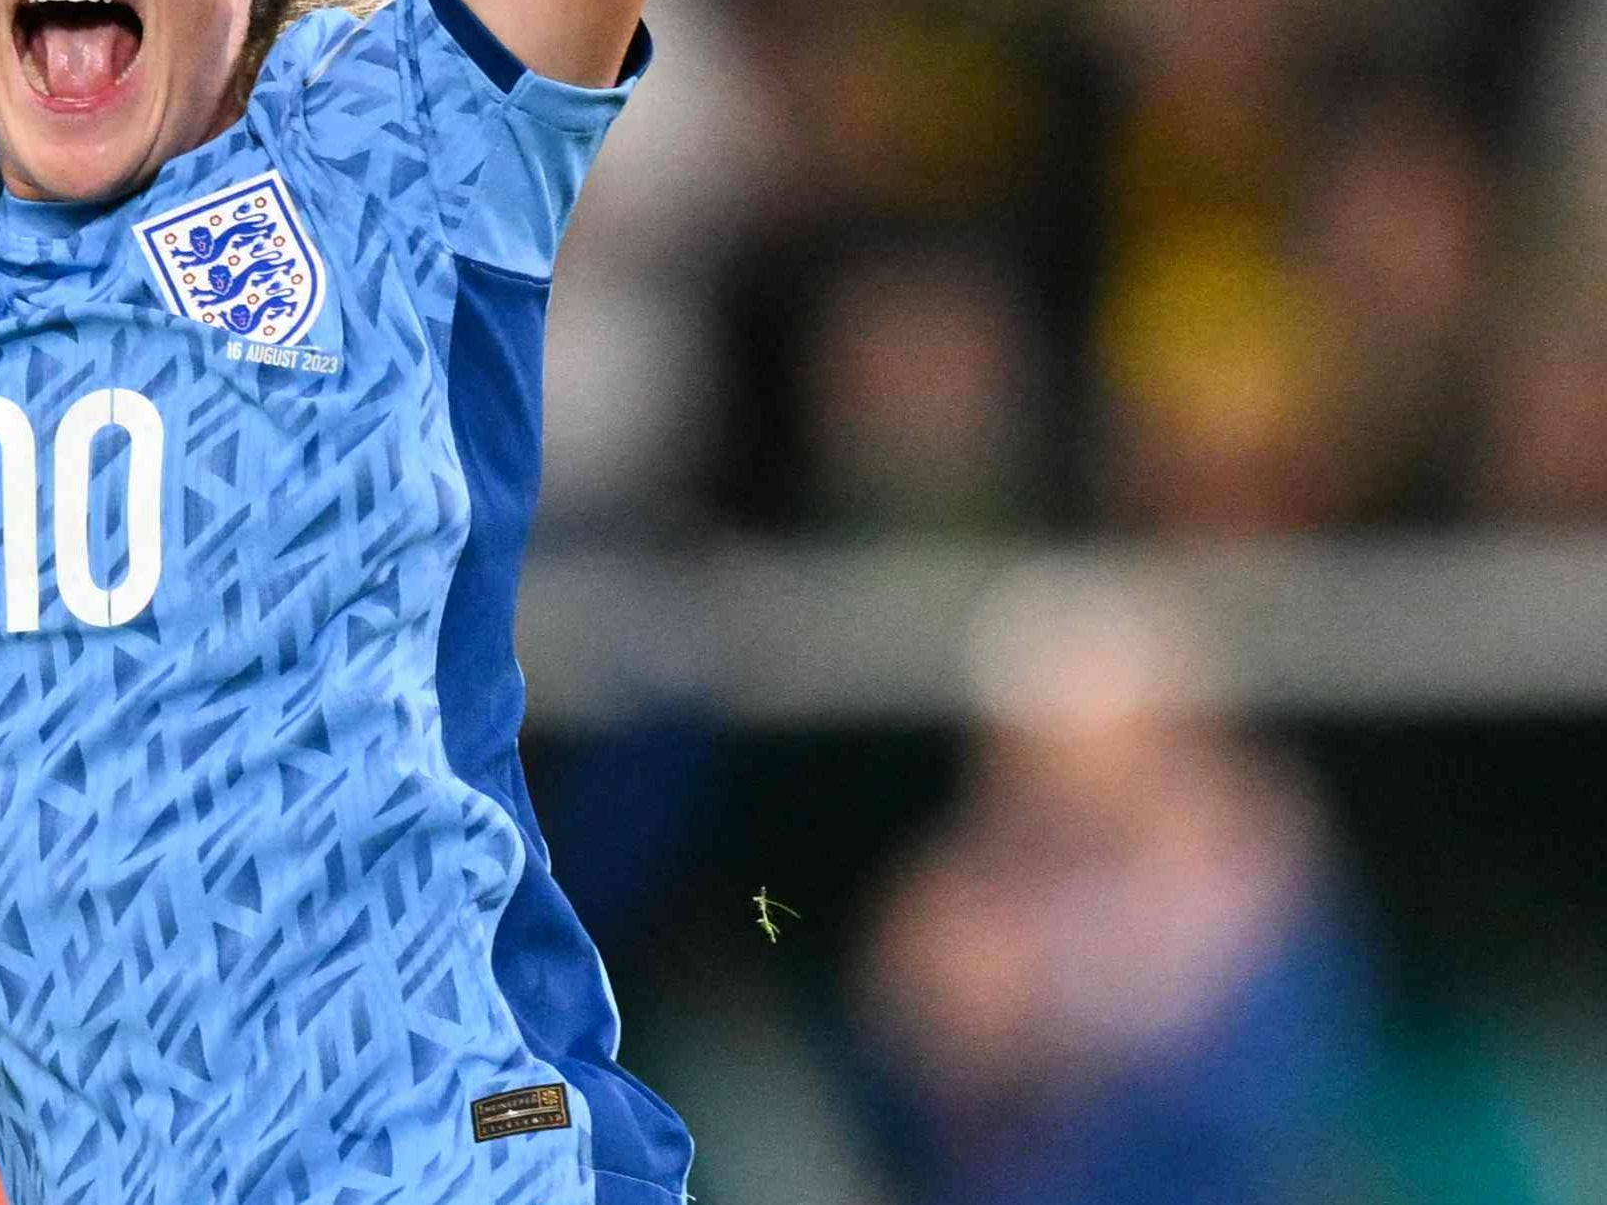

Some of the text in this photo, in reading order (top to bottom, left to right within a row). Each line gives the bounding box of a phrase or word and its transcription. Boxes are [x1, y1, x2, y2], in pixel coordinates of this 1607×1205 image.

[226, 341, 339, 374] 16 AUGUST 2023
